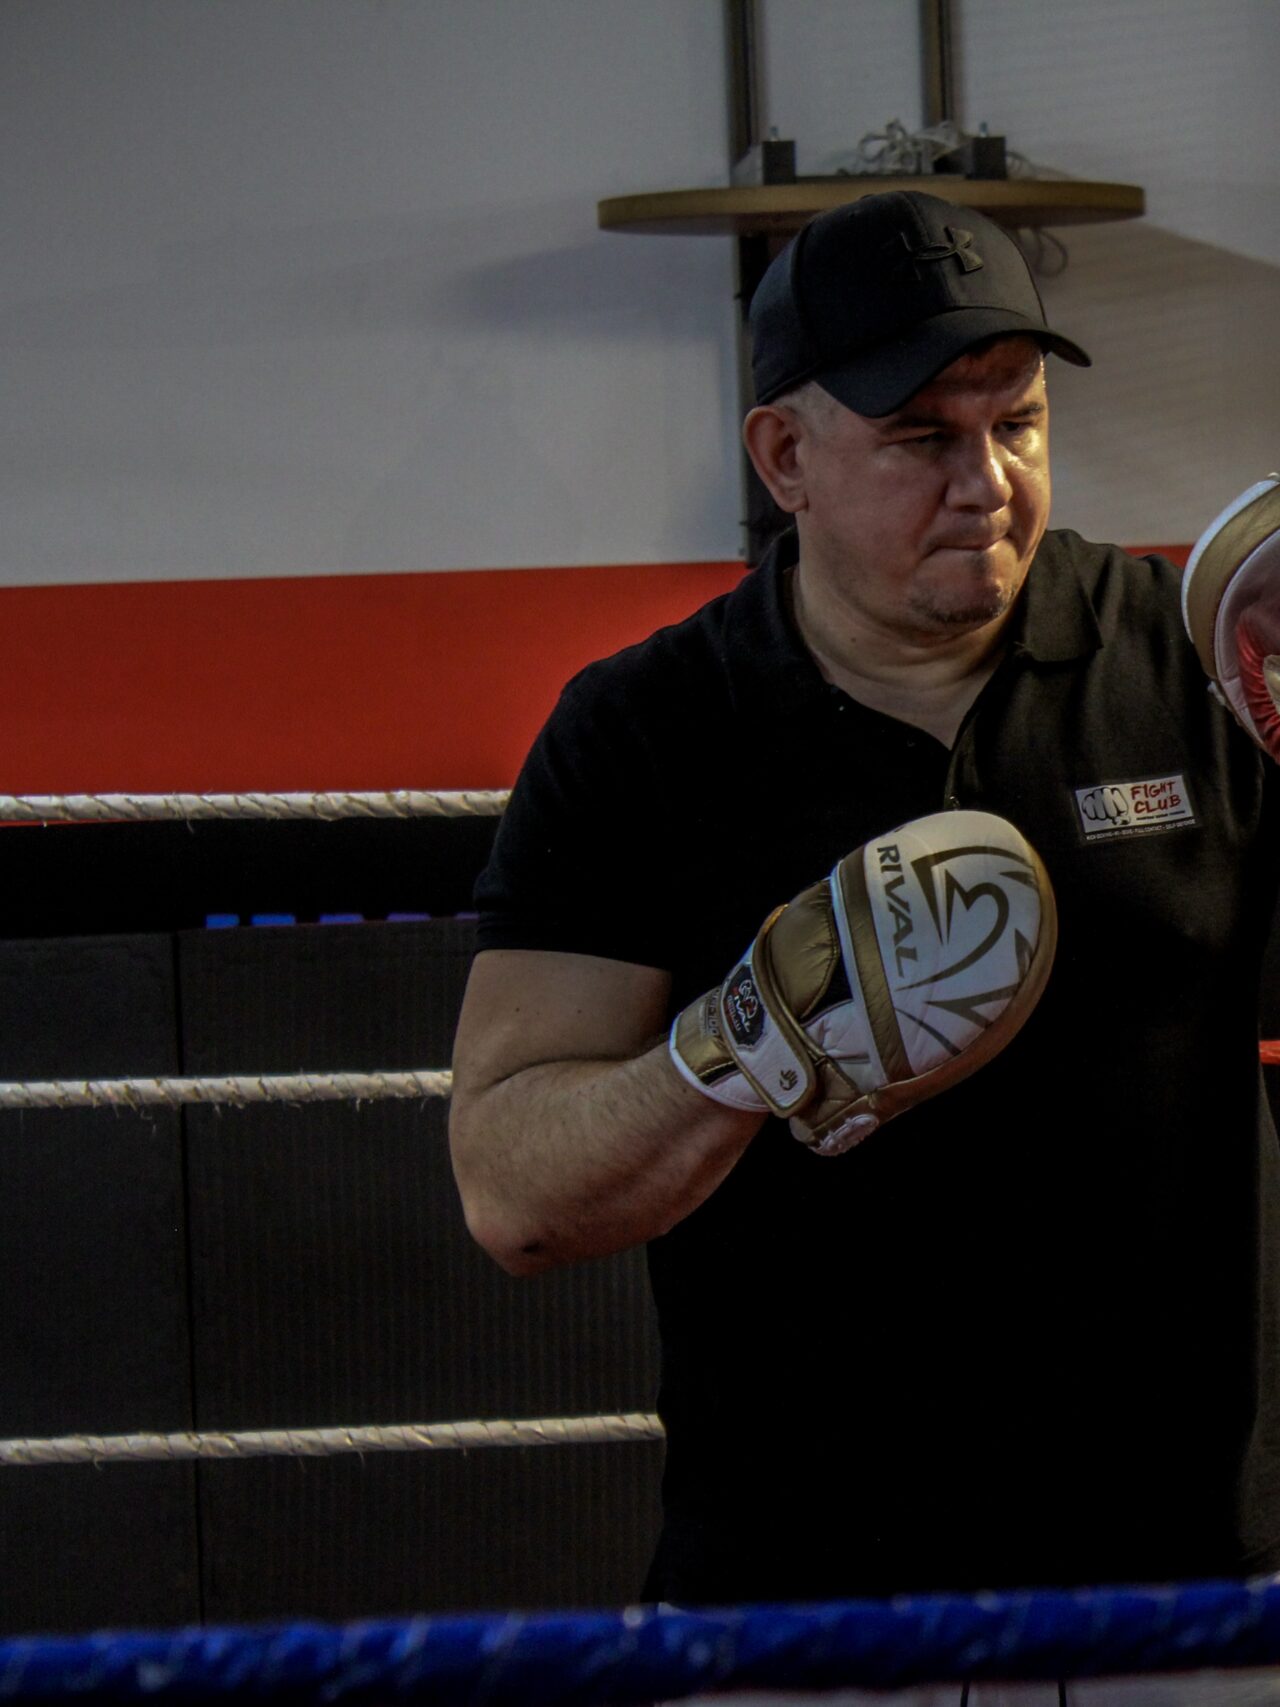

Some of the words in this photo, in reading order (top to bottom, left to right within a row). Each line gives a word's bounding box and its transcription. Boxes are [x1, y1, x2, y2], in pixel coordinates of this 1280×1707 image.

[1130, 781, 1177, 800] FIGHT
[1134, 794, 1182, 814] CLUB
[876, 844, 919, 979] RIVAL
